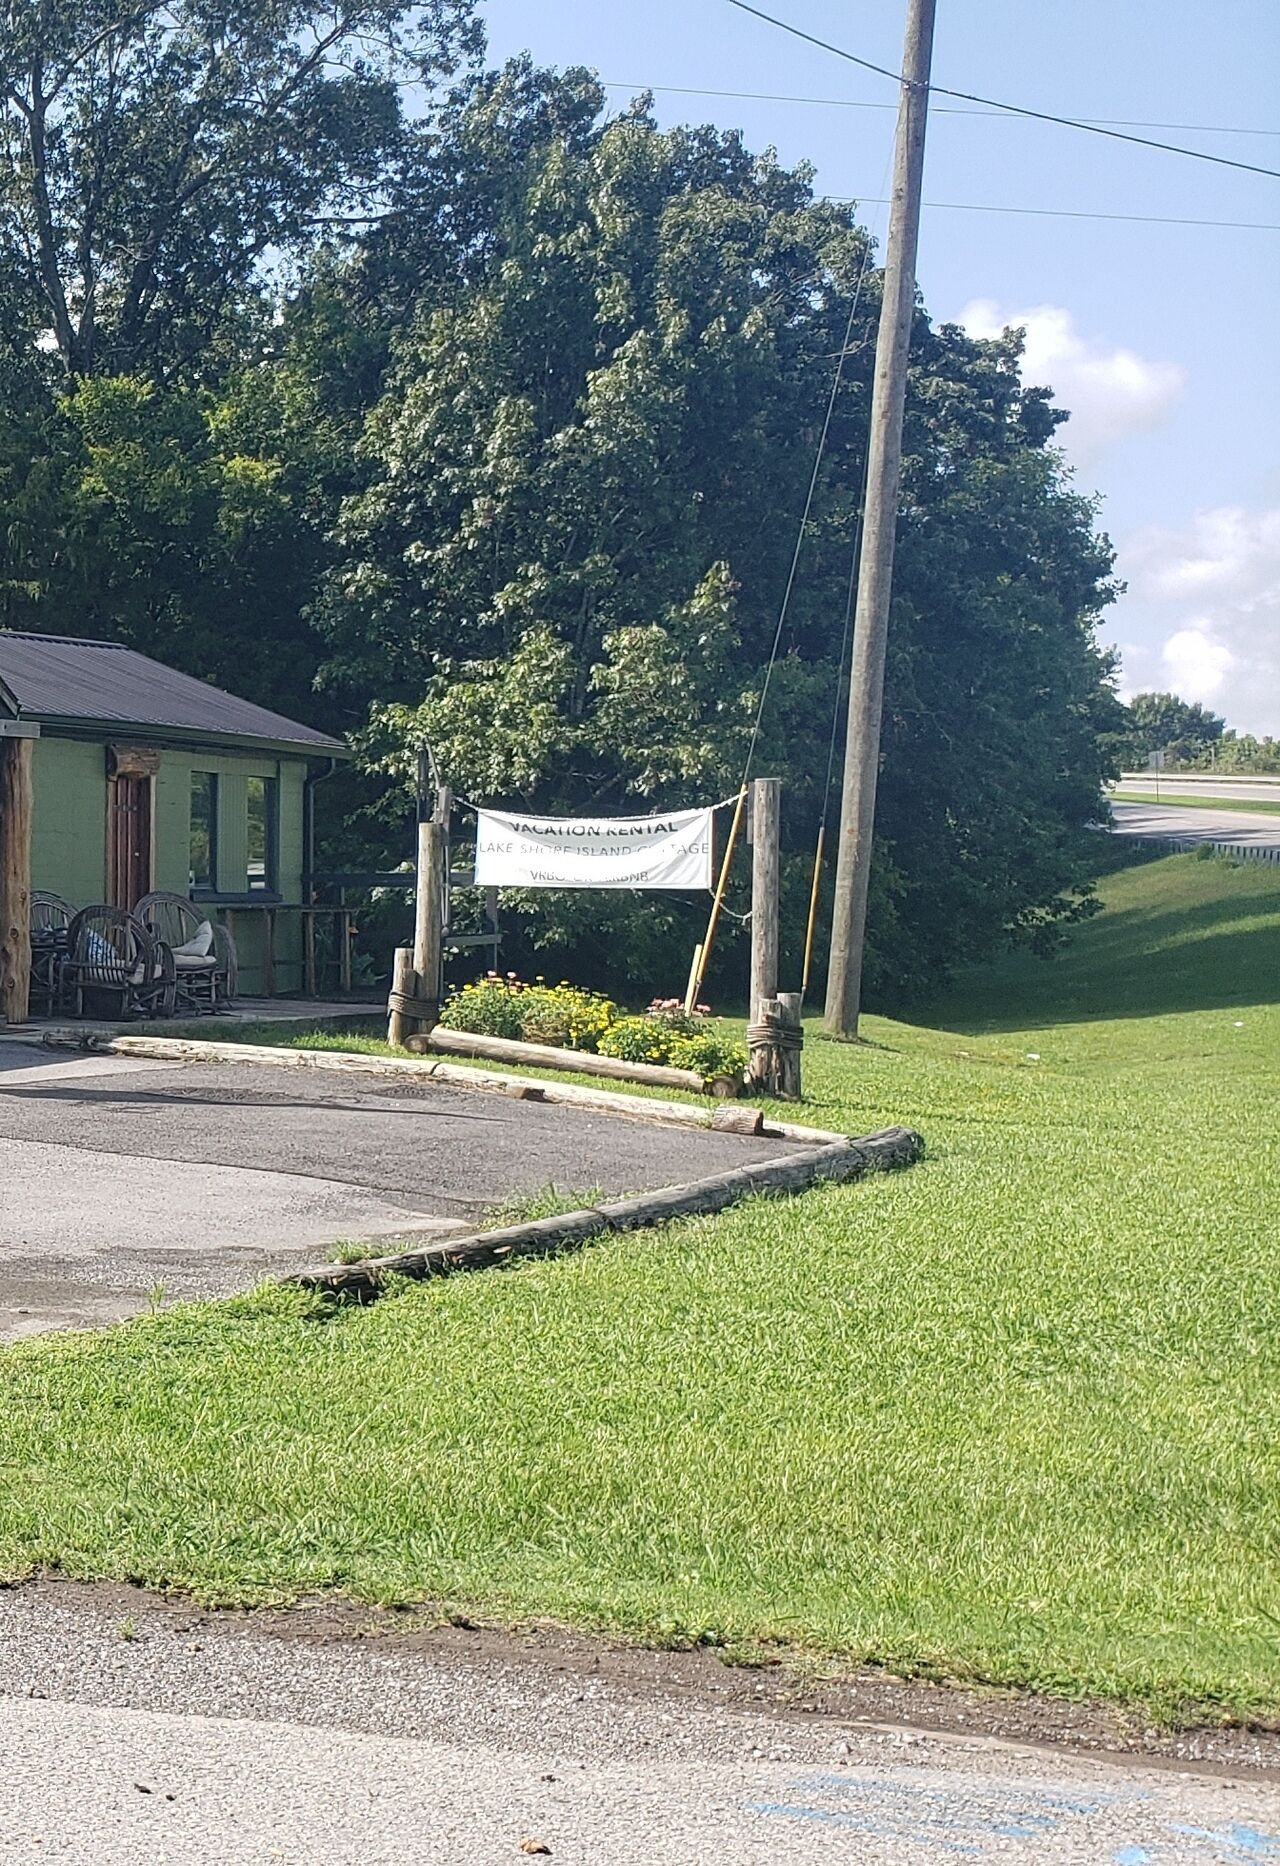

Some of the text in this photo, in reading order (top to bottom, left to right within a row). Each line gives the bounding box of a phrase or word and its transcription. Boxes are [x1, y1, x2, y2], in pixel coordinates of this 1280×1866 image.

[511, 822, 678, 836] VACATION RENTAL
[480, 842, 513, 853] LAKE
[577, 845, 631, 856] ISLAND
[637, 842, 709, 855] CTAGE
